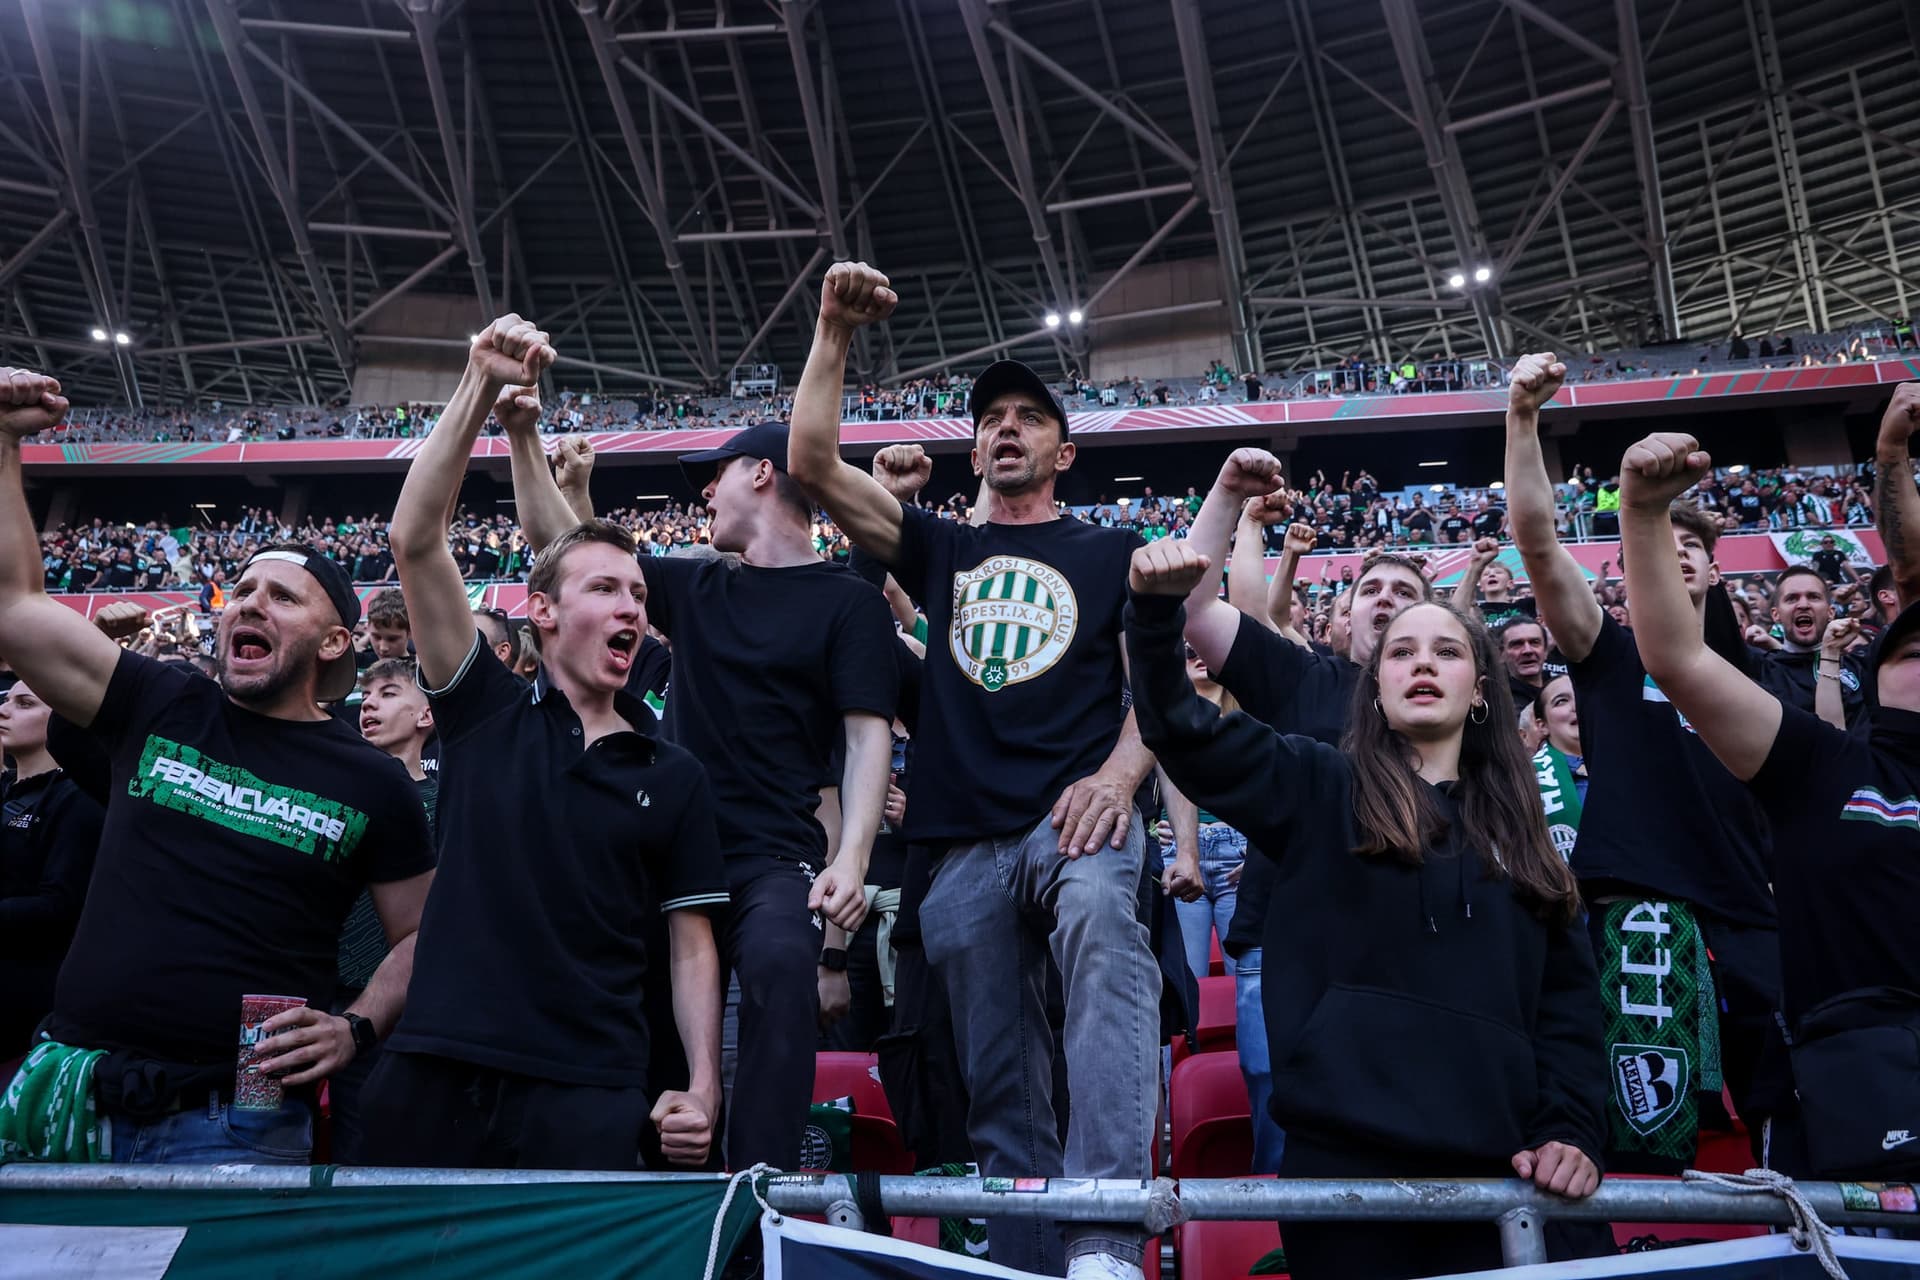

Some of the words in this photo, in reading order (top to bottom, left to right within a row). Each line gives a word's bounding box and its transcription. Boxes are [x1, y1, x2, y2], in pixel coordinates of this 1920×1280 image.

[1026, 562, 1066, 600] TORNA
[1053, 604, 1073, 644] CLUB
[967, 661, 979, 677] 18
[1011, 661, 1030, 677] 99
[150, 756, 346, 842] FERENCVÁROS
[1886, 1130, 1910, 1141] NIKE
